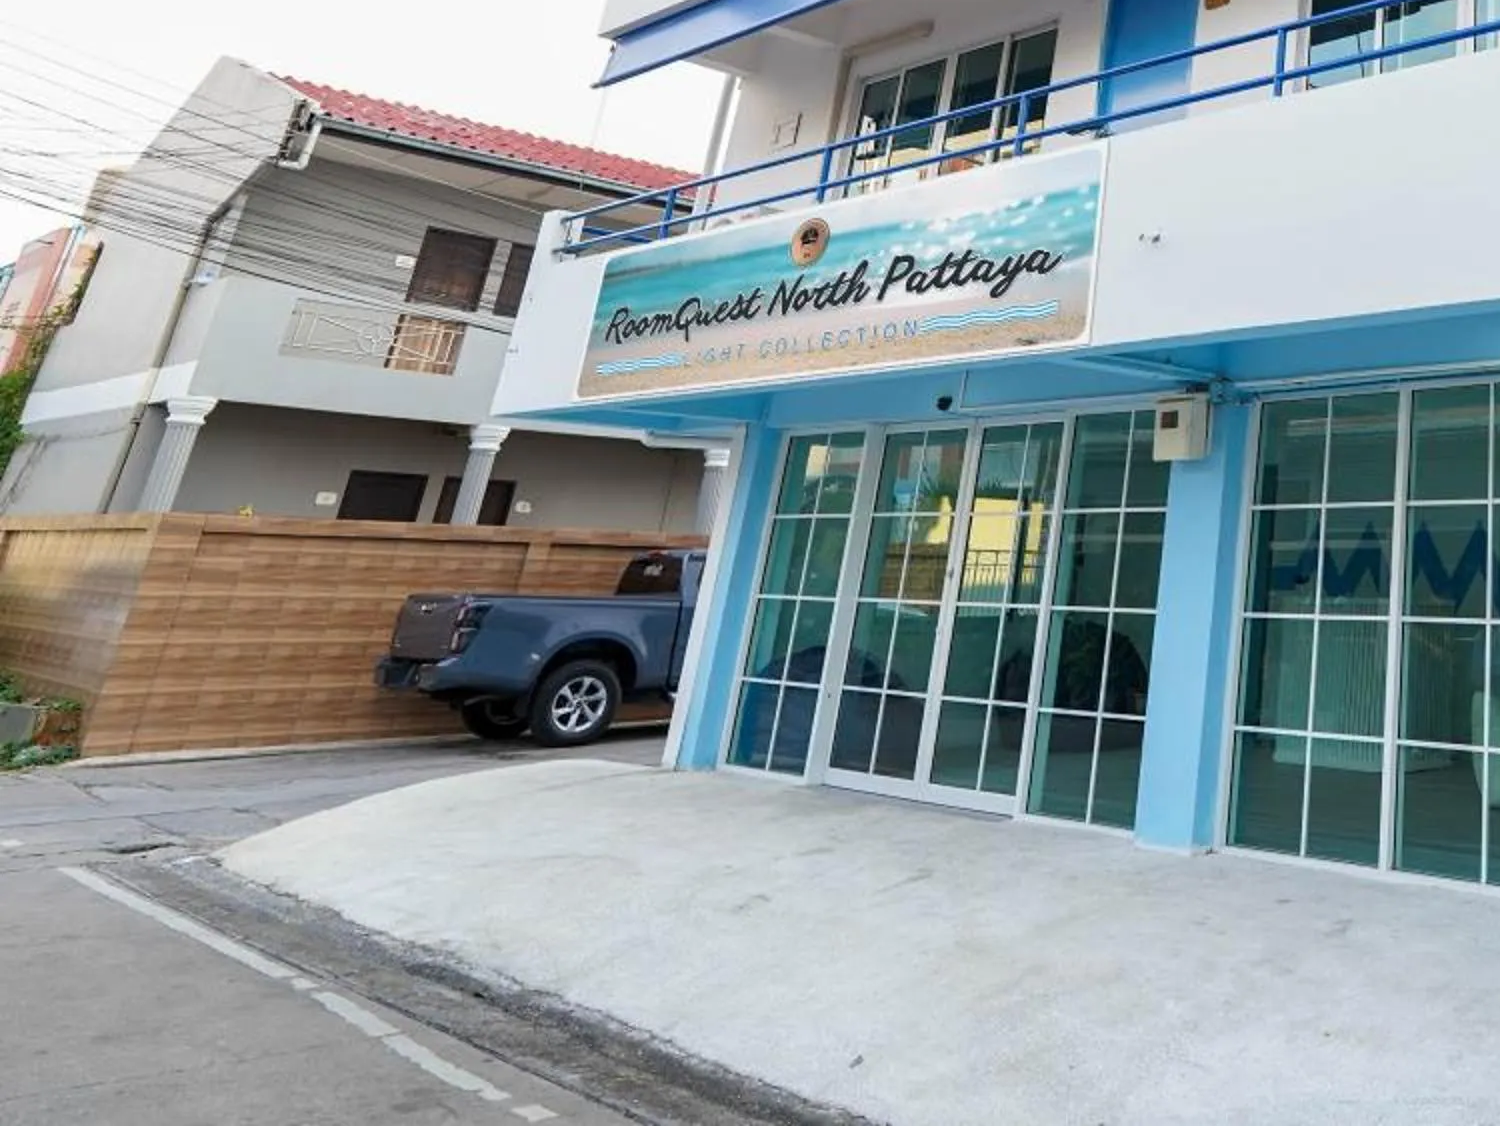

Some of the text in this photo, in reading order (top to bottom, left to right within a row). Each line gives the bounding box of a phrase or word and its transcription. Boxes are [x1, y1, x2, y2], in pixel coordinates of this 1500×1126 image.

[605, 249, 1063, 344] RoomQuest North Pattaya
